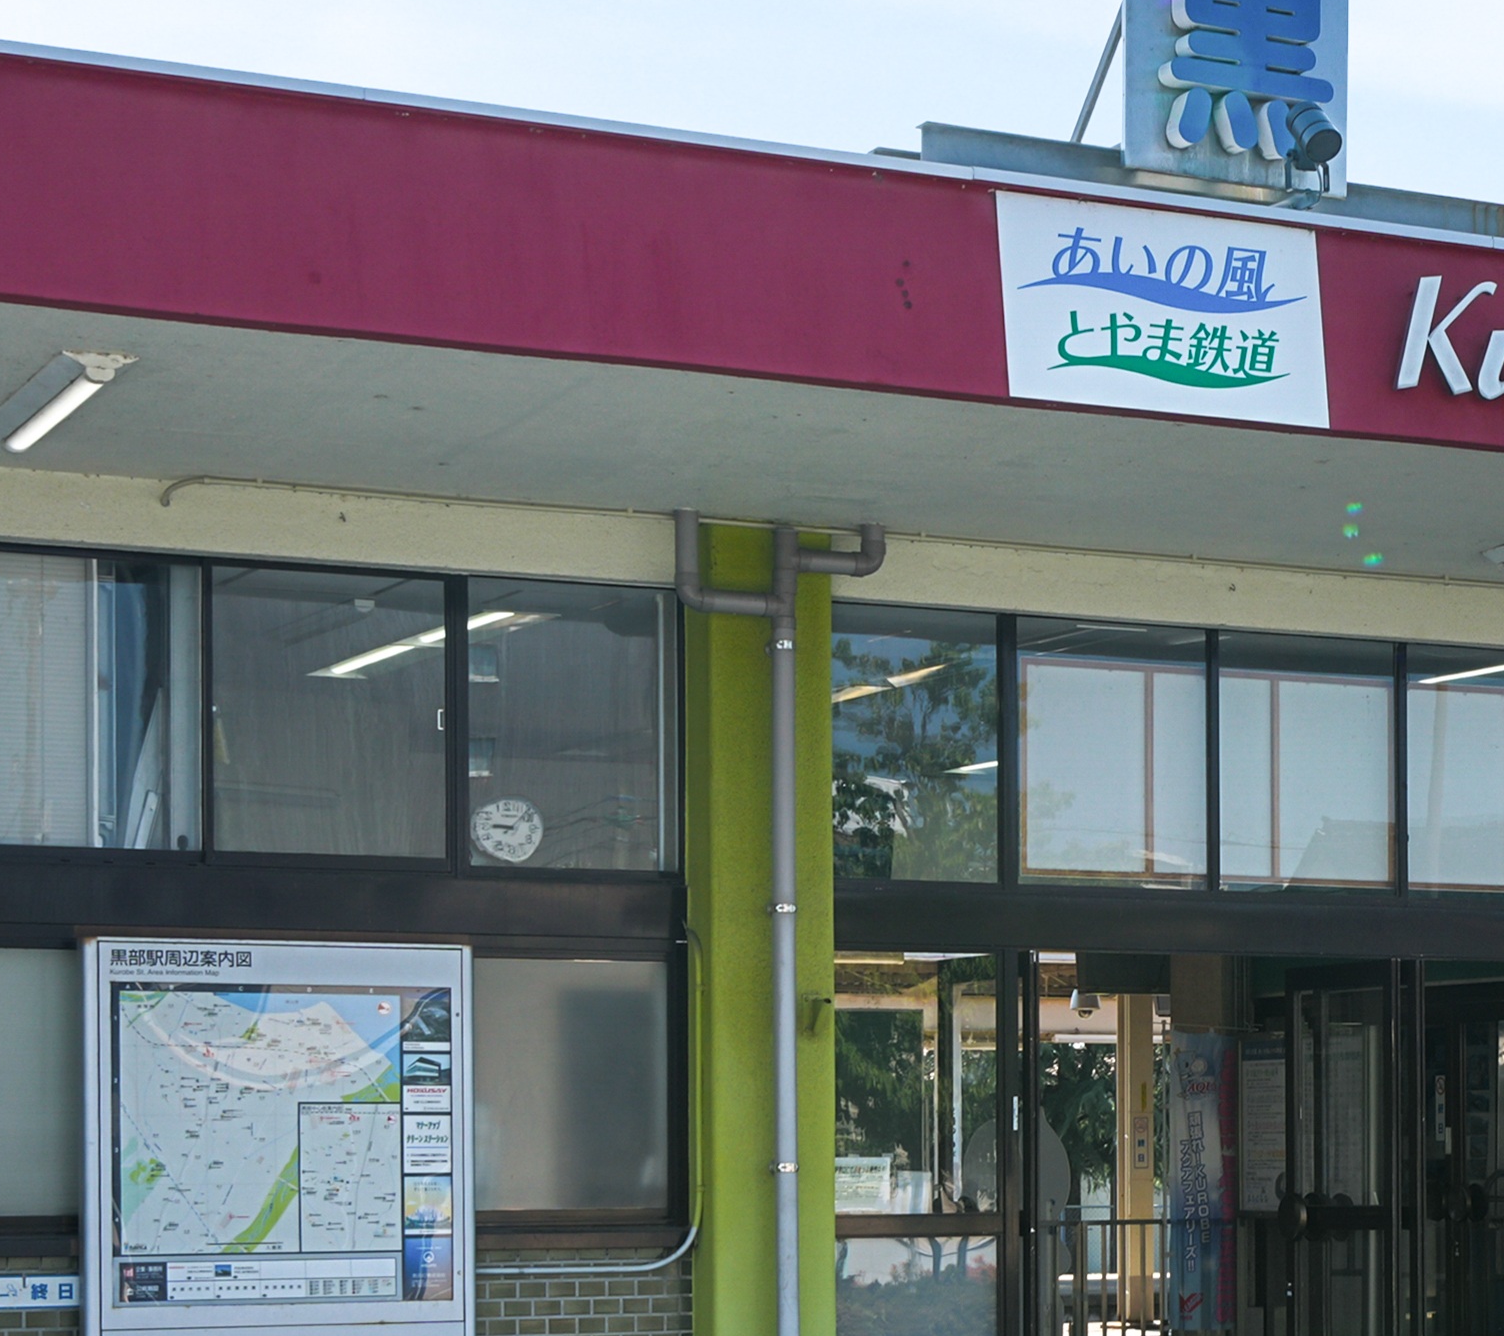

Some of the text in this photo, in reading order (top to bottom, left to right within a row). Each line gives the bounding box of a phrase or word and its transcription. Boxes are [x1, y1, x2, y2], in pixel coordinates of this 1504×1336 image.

[1050, 226, 1276, 304] あいの風
[1056, 309, 1281, 382] とやま鉄道
[109, 948, 253, 968] 黒部駅周辺案内図
[109, 968, 134, 976] Kurobe
[165, 969, 204, 977] Information
[205, 970, 220, 978] Map
[31, 1283, 74, 1301] 終日
